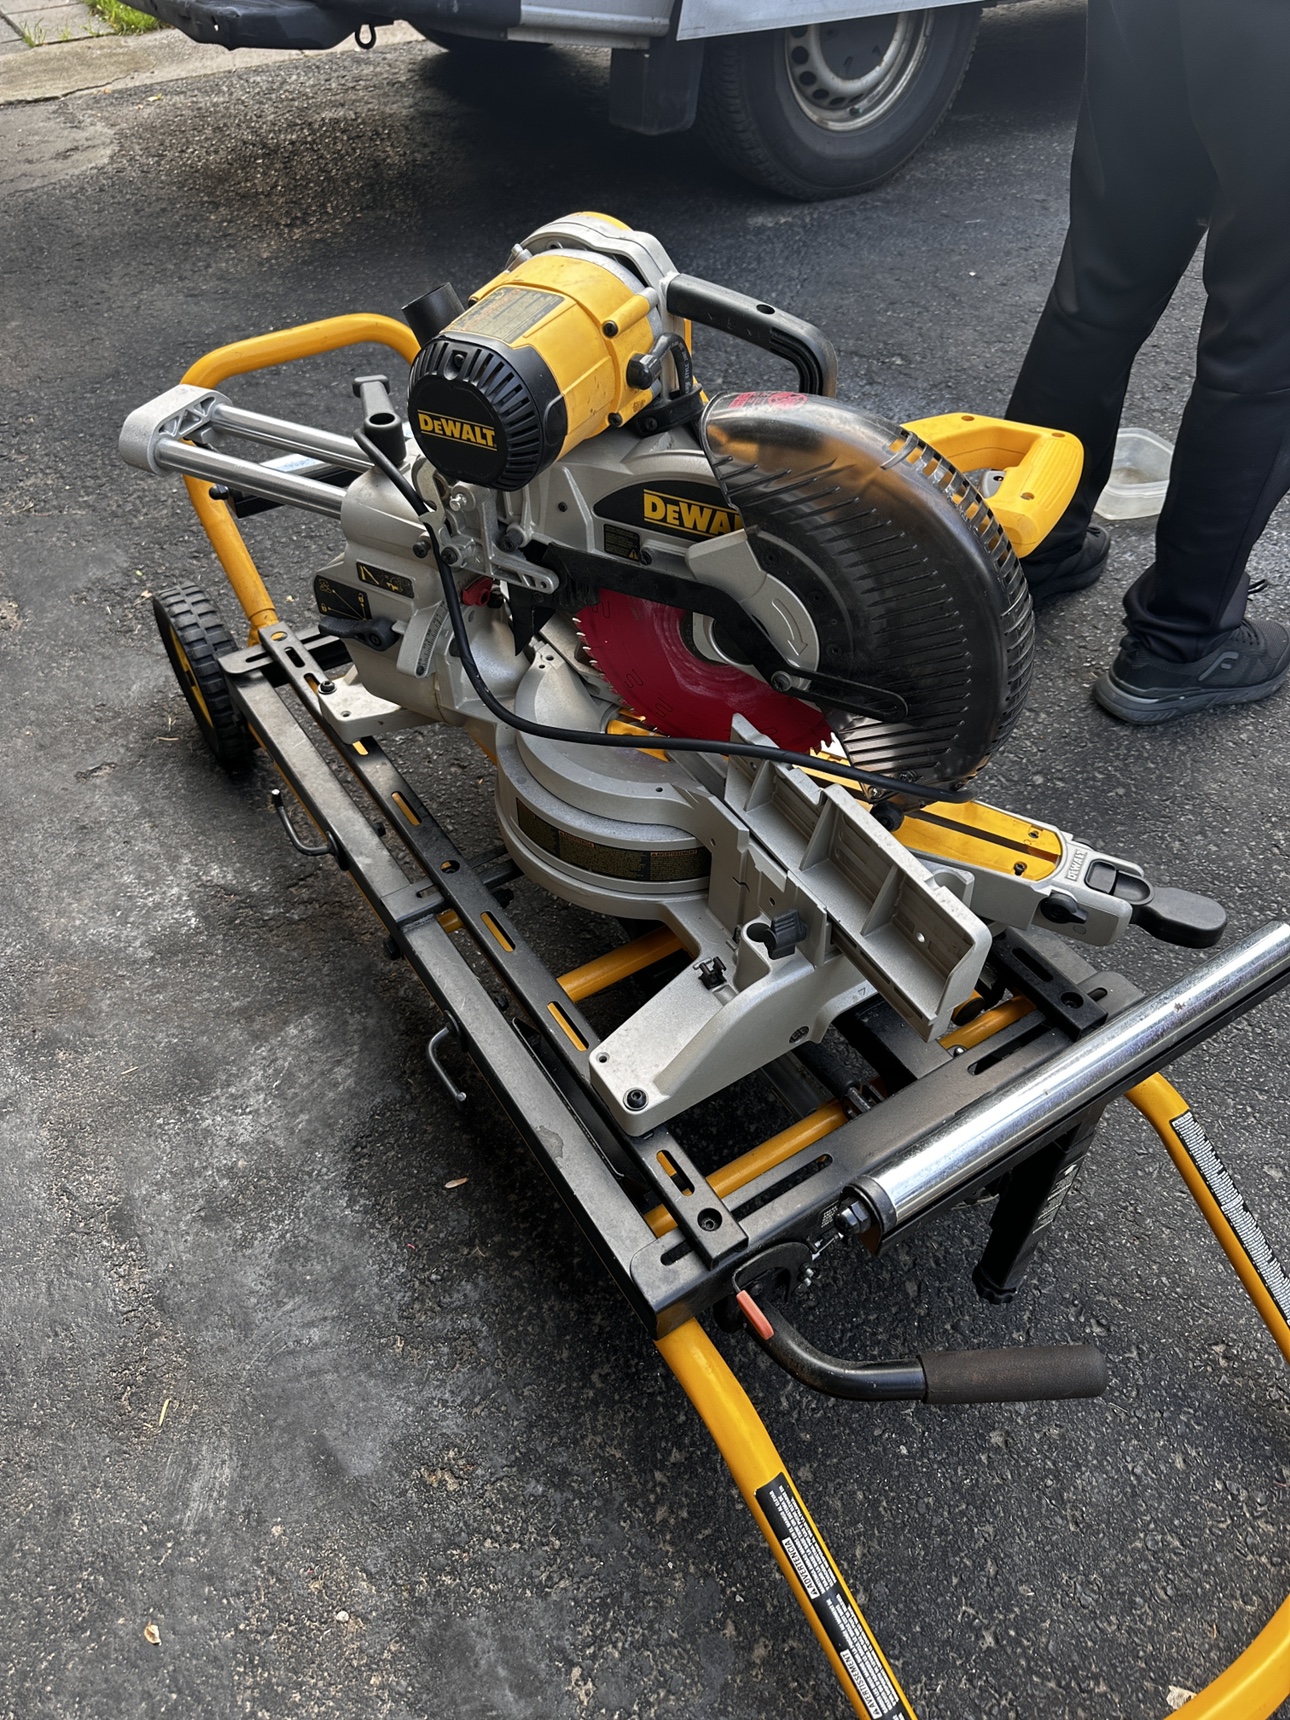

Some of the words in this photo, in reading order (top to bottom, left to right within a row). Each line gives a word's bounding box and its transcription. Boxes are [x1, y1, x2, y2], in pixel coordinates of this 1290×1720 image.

[418, 413, 496, 447] DEWALT
[1067, 850, 1086, 880] DEWALT
[784, 1539, 813, 1589] ADVERTENCIA
[841, 1650, 876, 1709] AVERTISSEMENT
